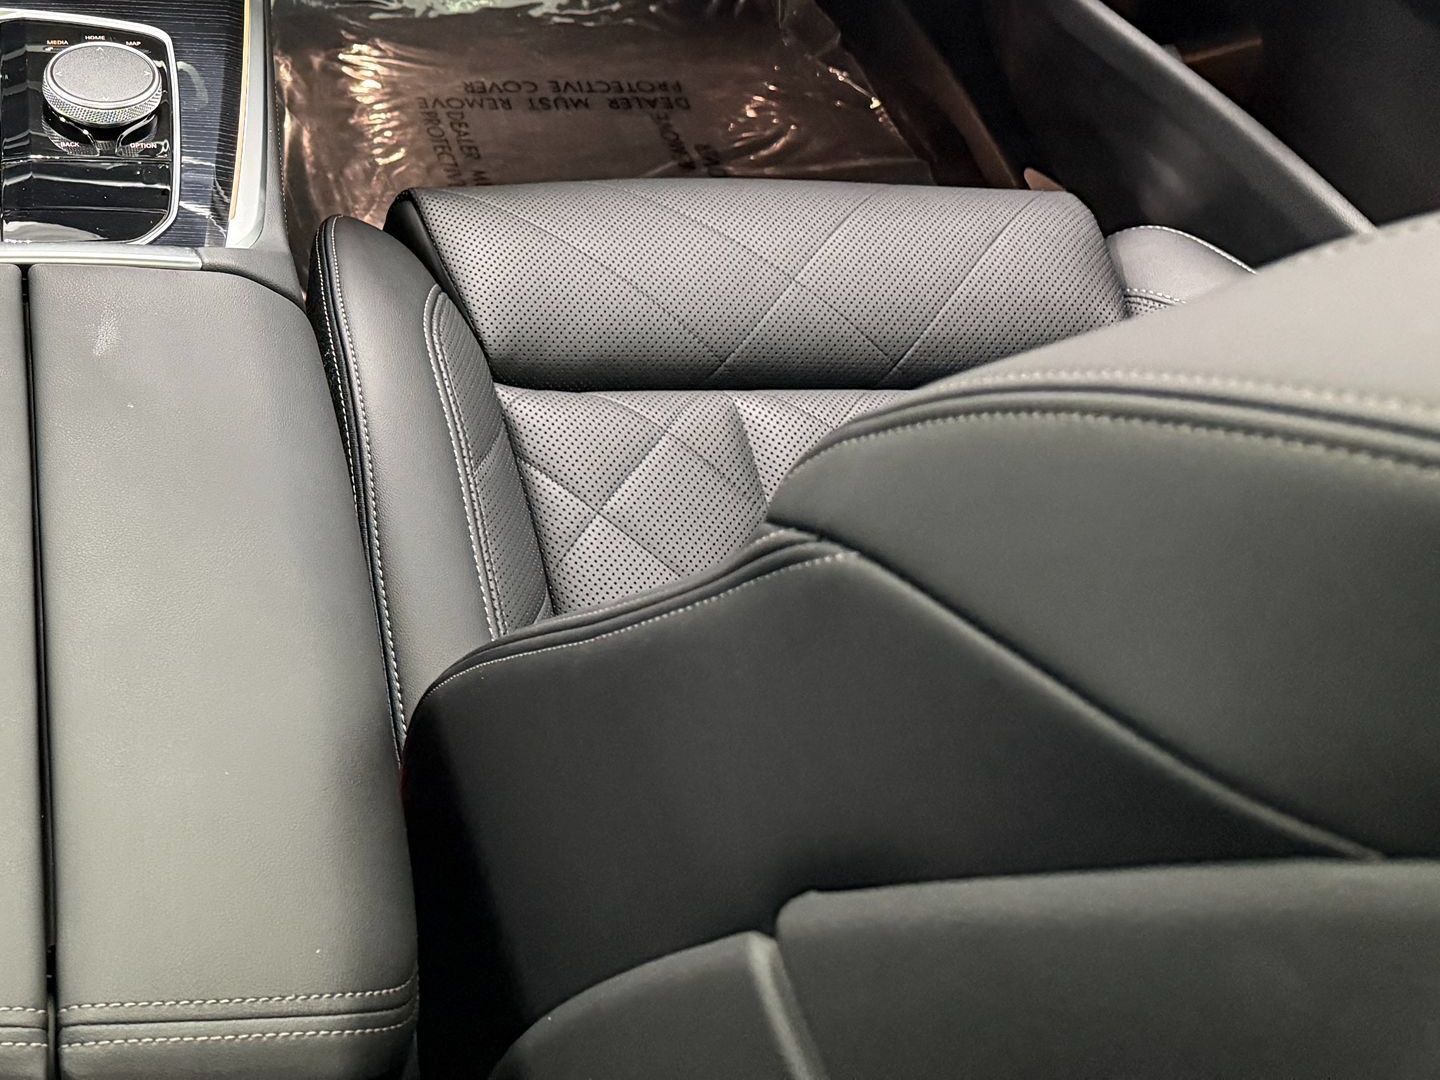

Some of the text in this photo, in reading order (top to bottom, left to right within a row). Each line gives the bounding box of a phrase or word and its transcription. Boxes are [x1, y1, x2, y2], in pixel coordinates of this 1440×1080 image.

[464, 80, 683, 94] PROTECTIVE COVER
[416, 96, 691, 111] DEALER MUST REMOVE
[421, 111, 466, 185] PROTECTIV
[446, 111, 482, 160] DEALER
